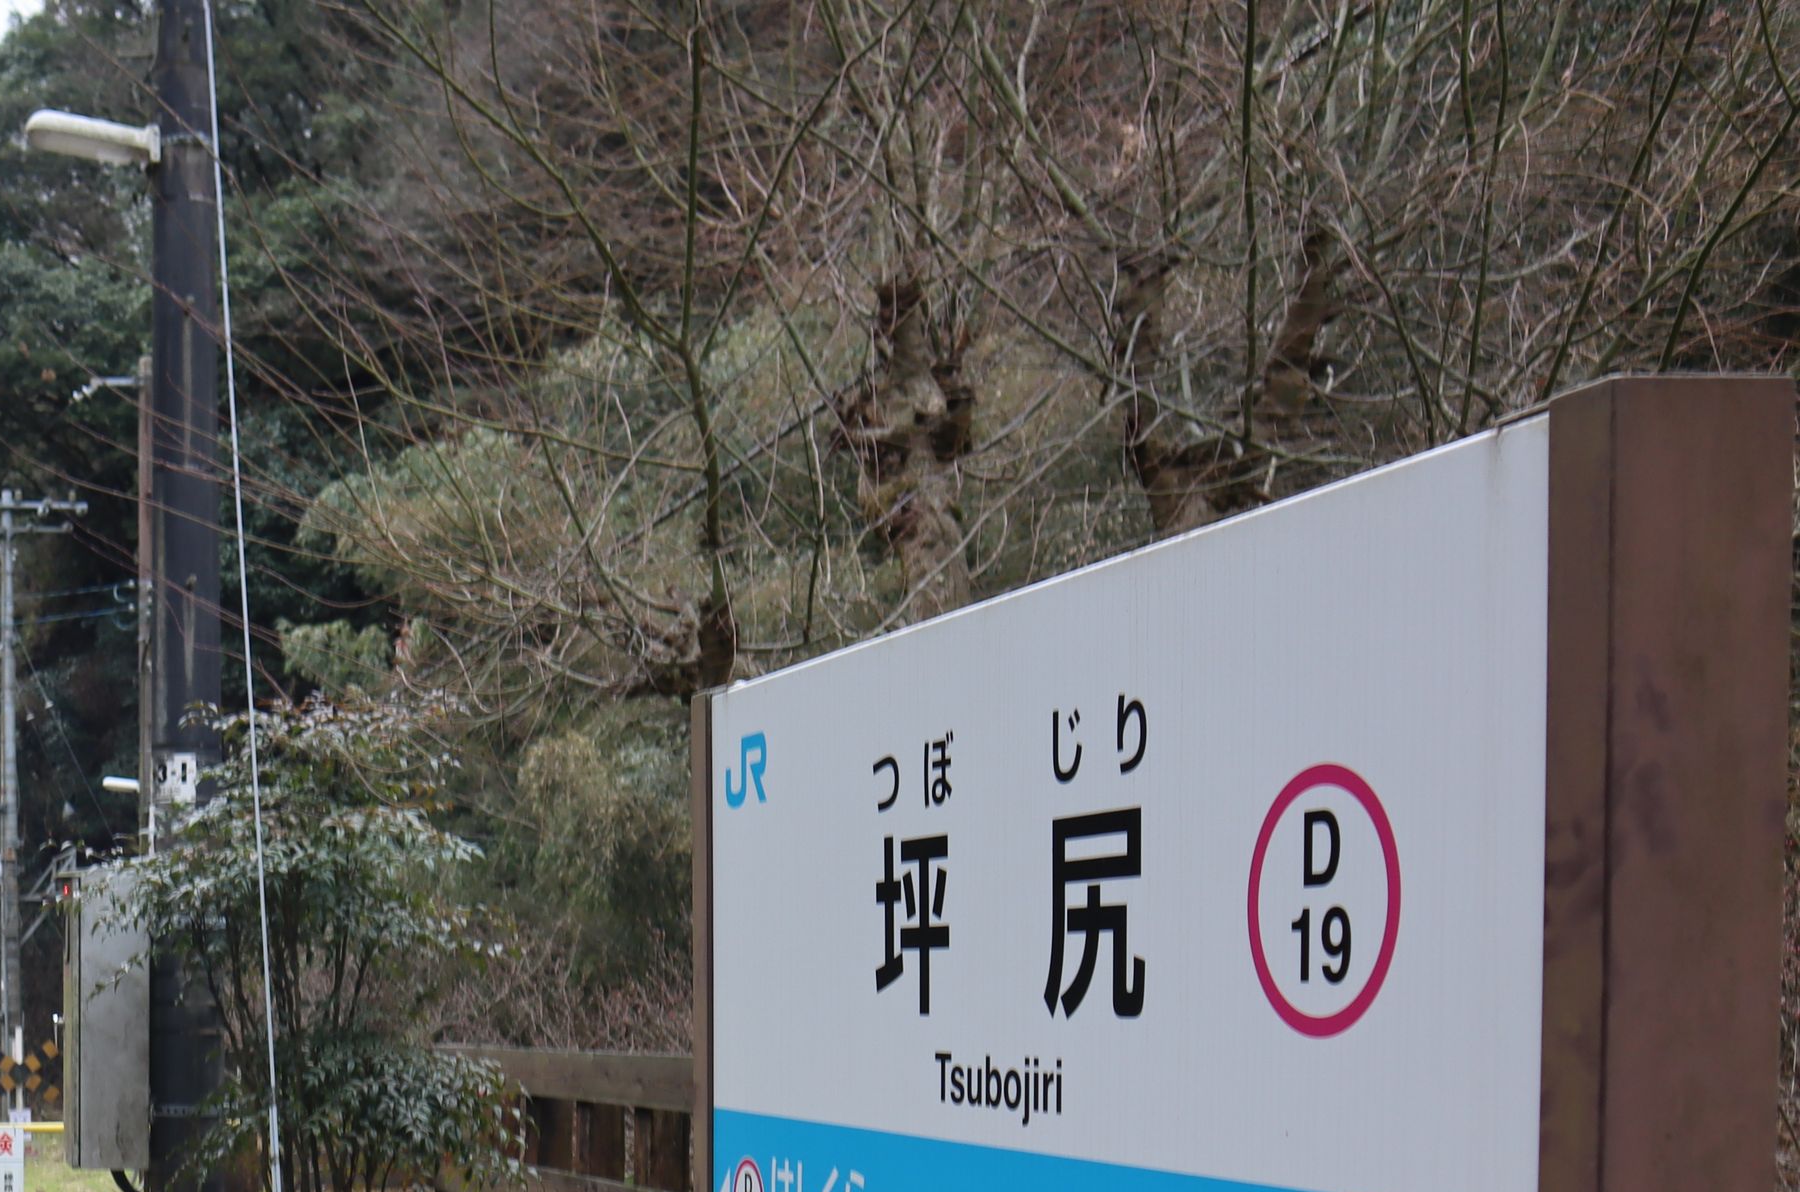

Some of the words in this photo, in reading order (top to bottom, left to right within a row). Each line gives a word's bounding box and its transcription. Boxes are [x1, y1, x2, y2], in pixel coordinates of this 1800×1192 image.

[724, 731, 768, 809] JR
[1303, 809, 1341, 888] D
[1291, 905, 1353, 985] 19
[935, 1052, 1063, 1126] Tsubojiri
